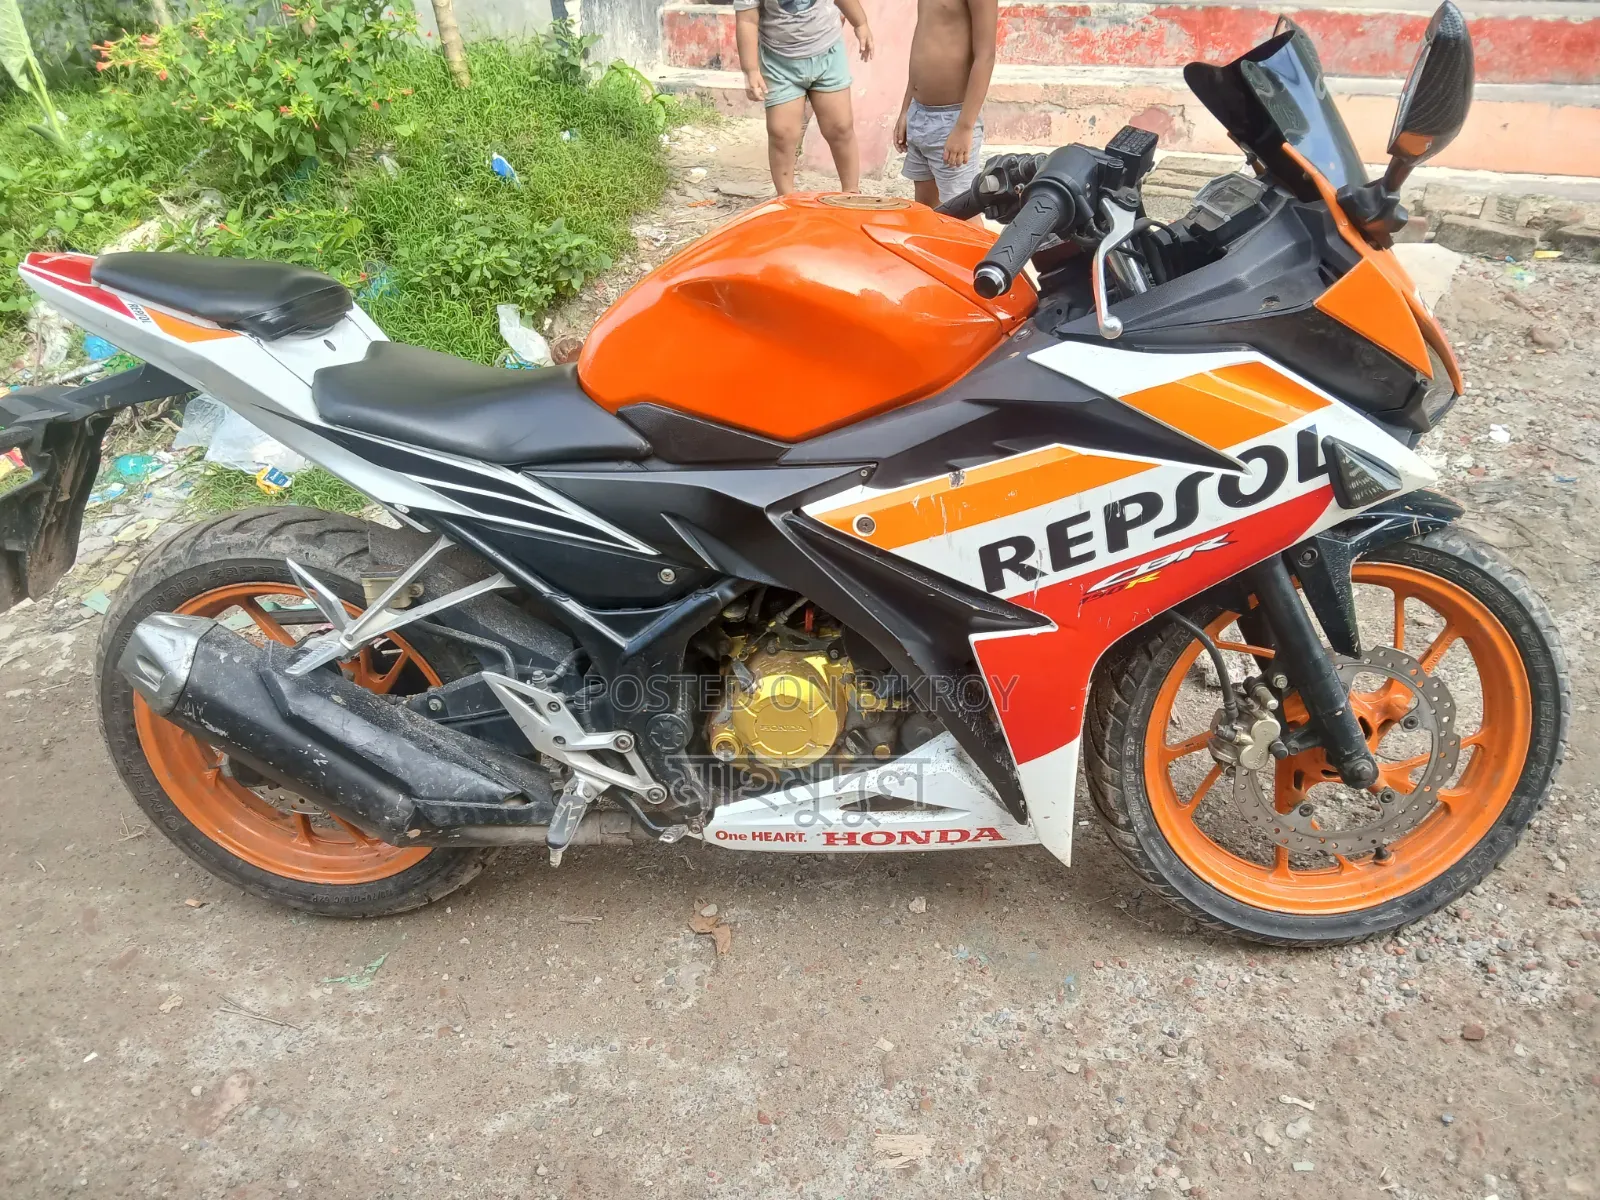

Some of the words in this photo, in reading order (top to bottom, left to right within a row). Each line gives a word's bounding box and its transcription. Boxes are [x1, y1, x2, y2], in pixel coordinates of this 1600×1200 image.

[978, 424, 1330, 593] REPSOL
[1084, 530, 1238, 595] CBR
[760, 724, 807, 732] HONDA
[715, 830, 747, 842] One
[751, 831, 807, 843] HEART.
[822, 827, 1007, 846] HONDA
